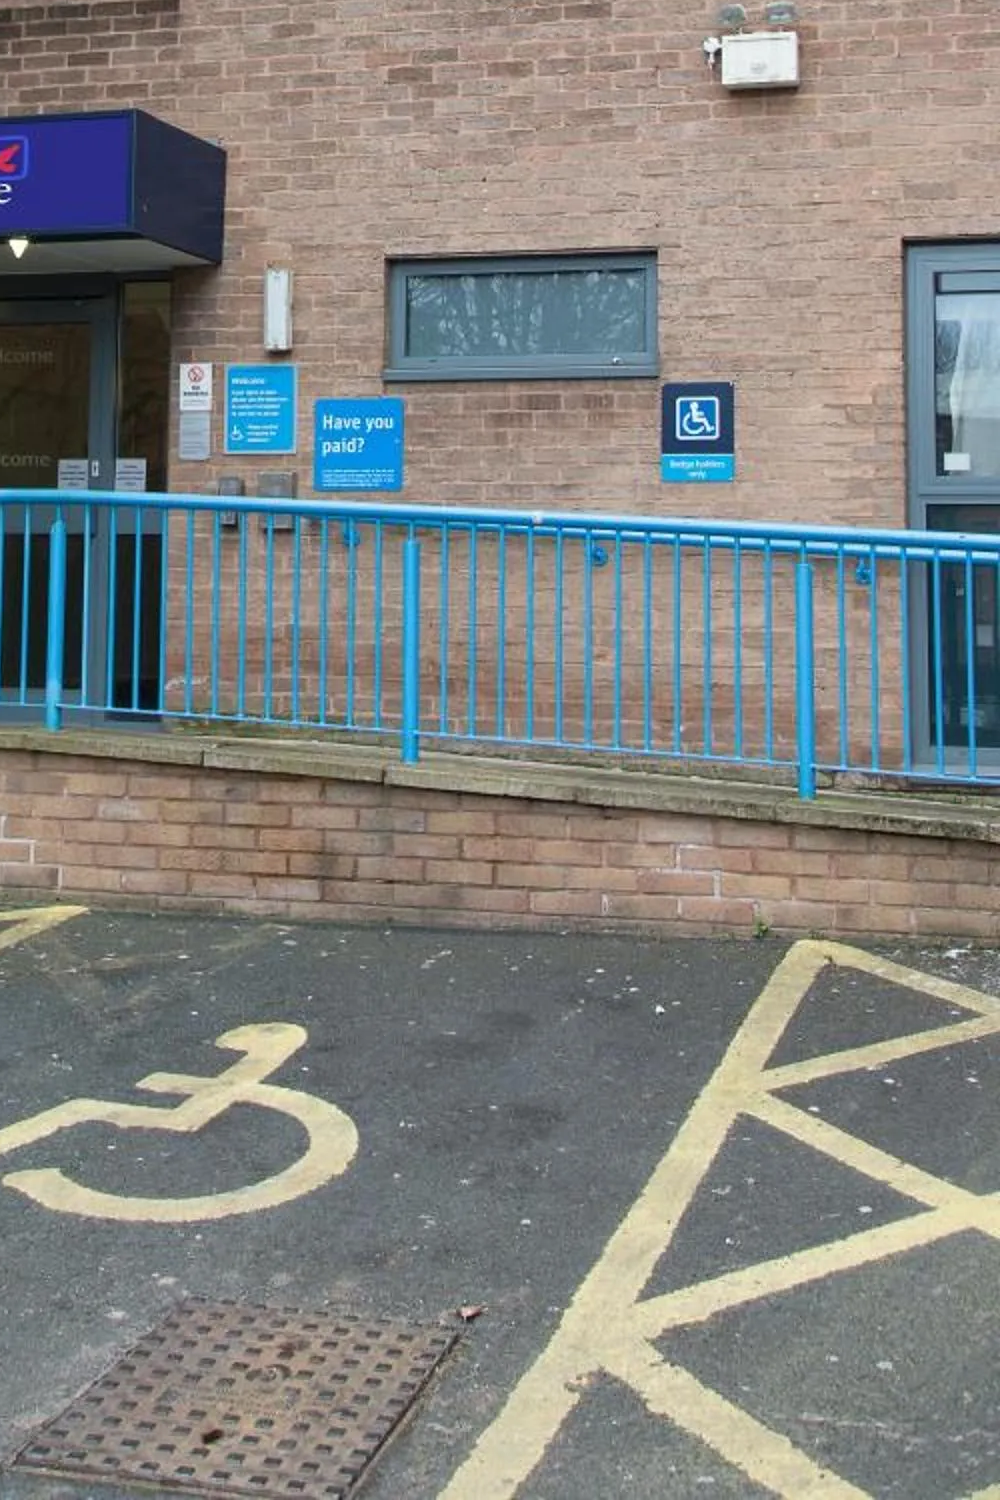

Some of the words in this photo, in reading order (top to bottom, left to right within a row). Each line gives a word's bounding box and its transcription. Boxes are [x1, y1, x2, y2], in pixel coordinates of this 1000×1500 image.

[323, 415, 360, 430] Have
[365, 417, 394, 433] you
[321, 437, 365, 456] paid?
